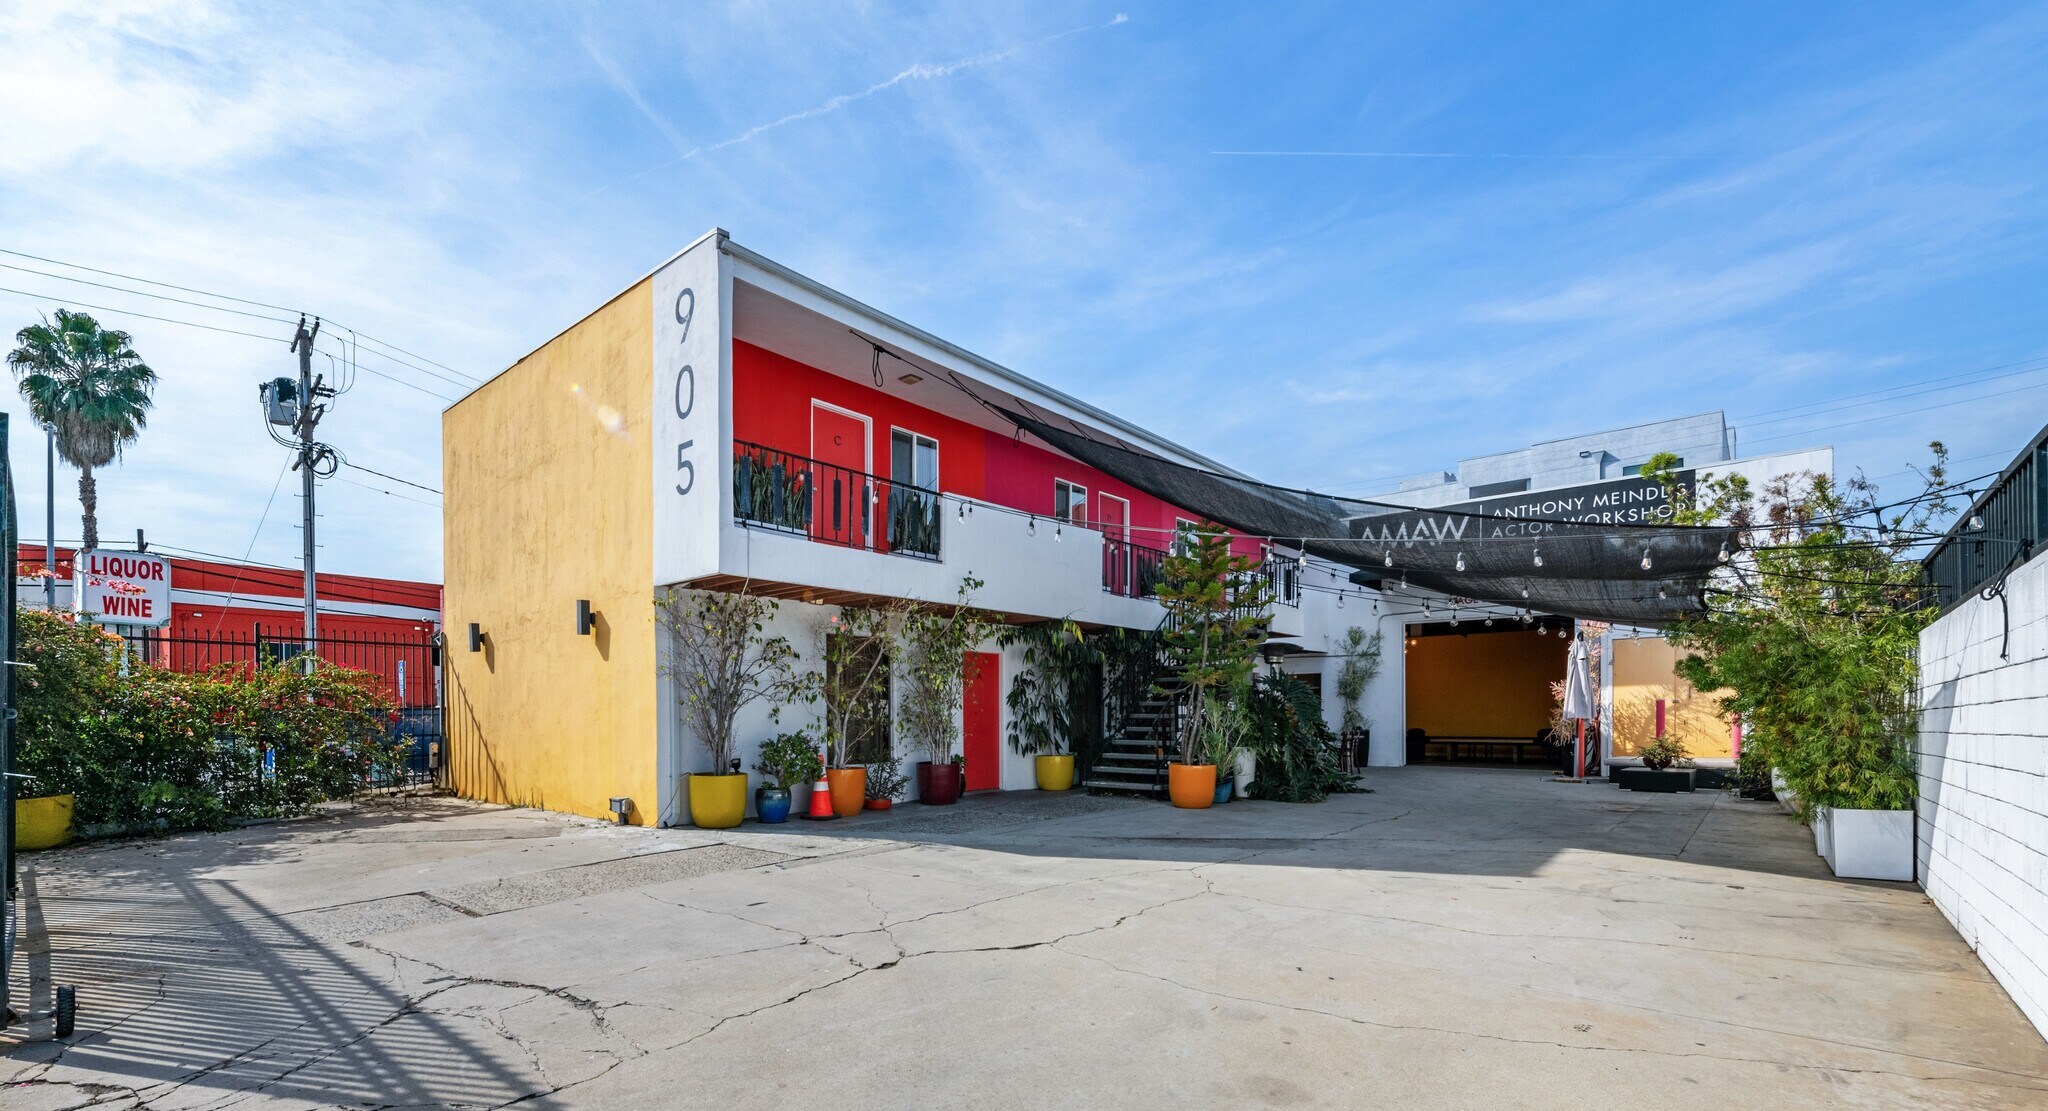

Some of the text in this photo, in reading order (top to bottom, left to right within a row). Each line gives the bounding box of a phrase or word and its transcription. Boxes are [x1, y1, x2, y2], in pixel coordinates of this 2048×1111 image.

[674, 286, 695, 496] 905
[834, 435, 842, 446] C
[1492, 482, 1687, 521] ANTHONY MEINDLS
[1360, 515, 1470, 549] AMAW
[1492, 502, 1686, 539] ACTOR WORKSHOP
[90, 555, 164, 581] LIQUOR
[102, 595, 153, 618] WINE
